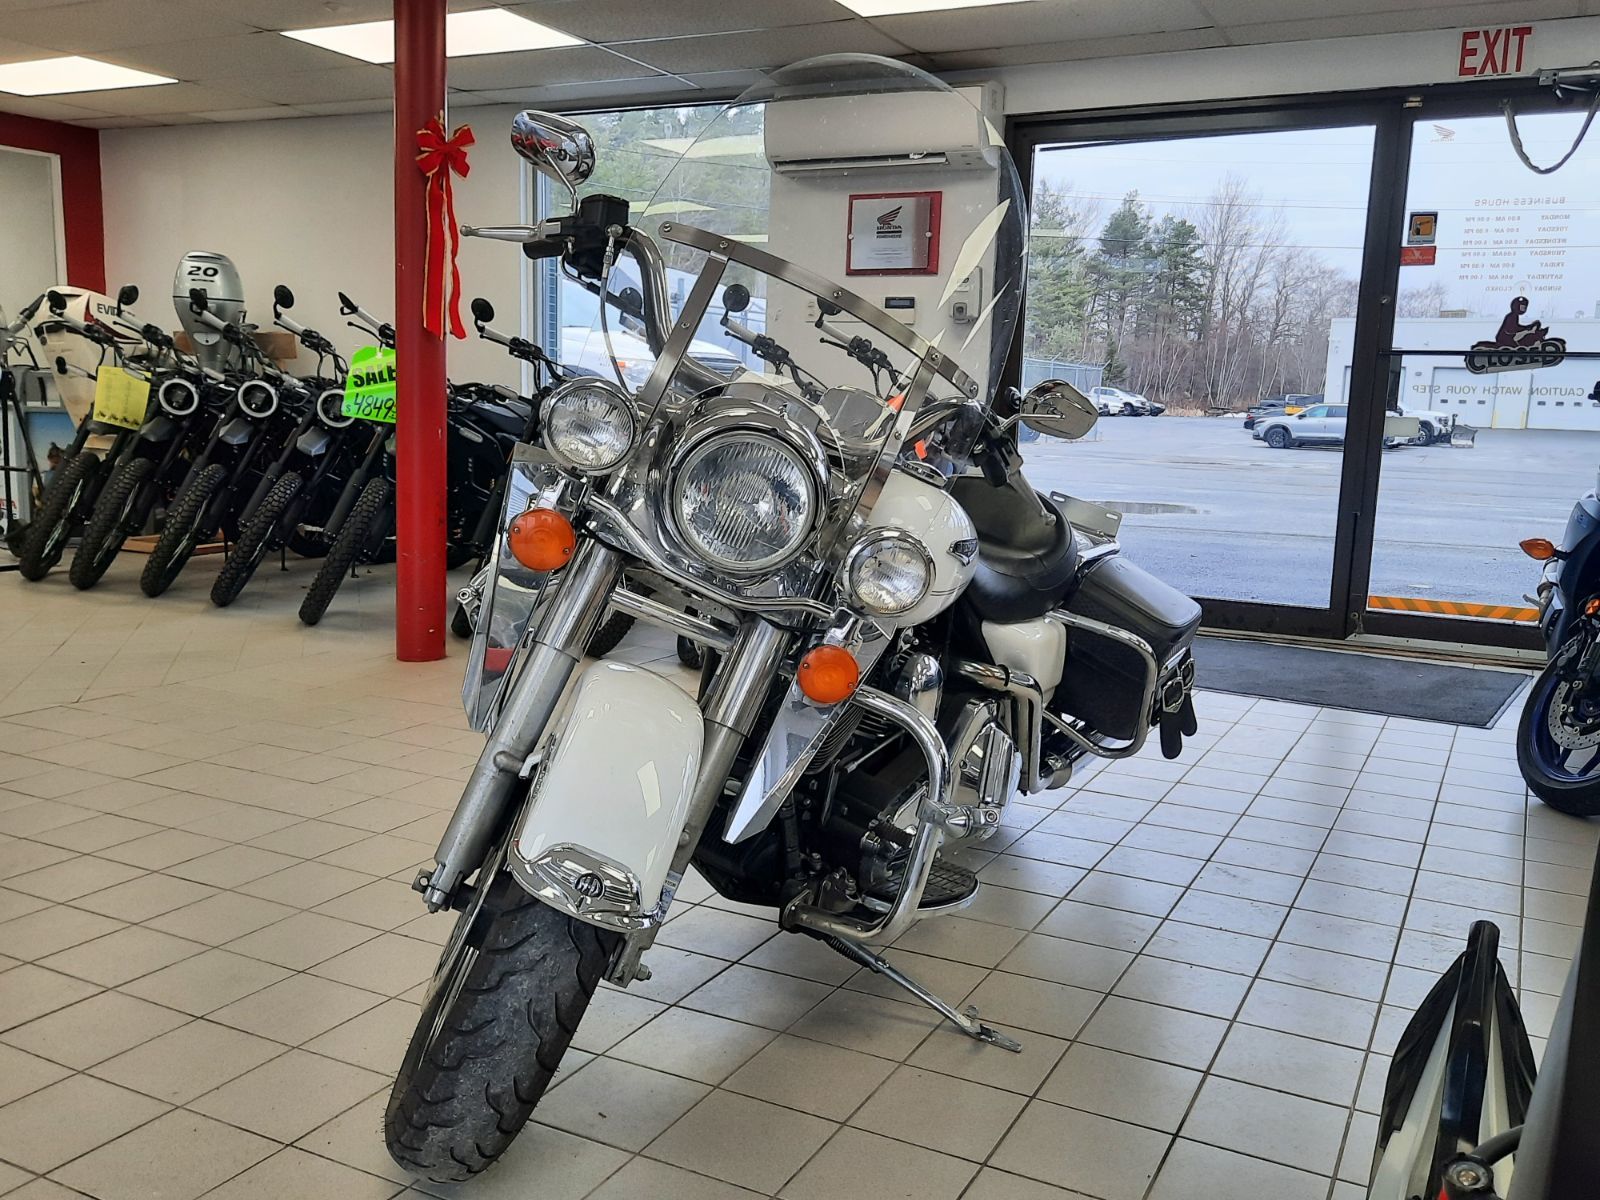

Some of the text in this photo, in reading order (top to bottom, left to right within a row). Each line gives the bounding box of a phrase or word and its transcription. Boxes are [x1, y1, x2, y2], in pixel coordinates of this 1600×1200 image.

[1458, 26, 1532, 76] EXIT
[187, 265, 219, 277] 20
[1468, 341, 1562, 371] CLOSED
[352, 361, 396, 388] SALE
